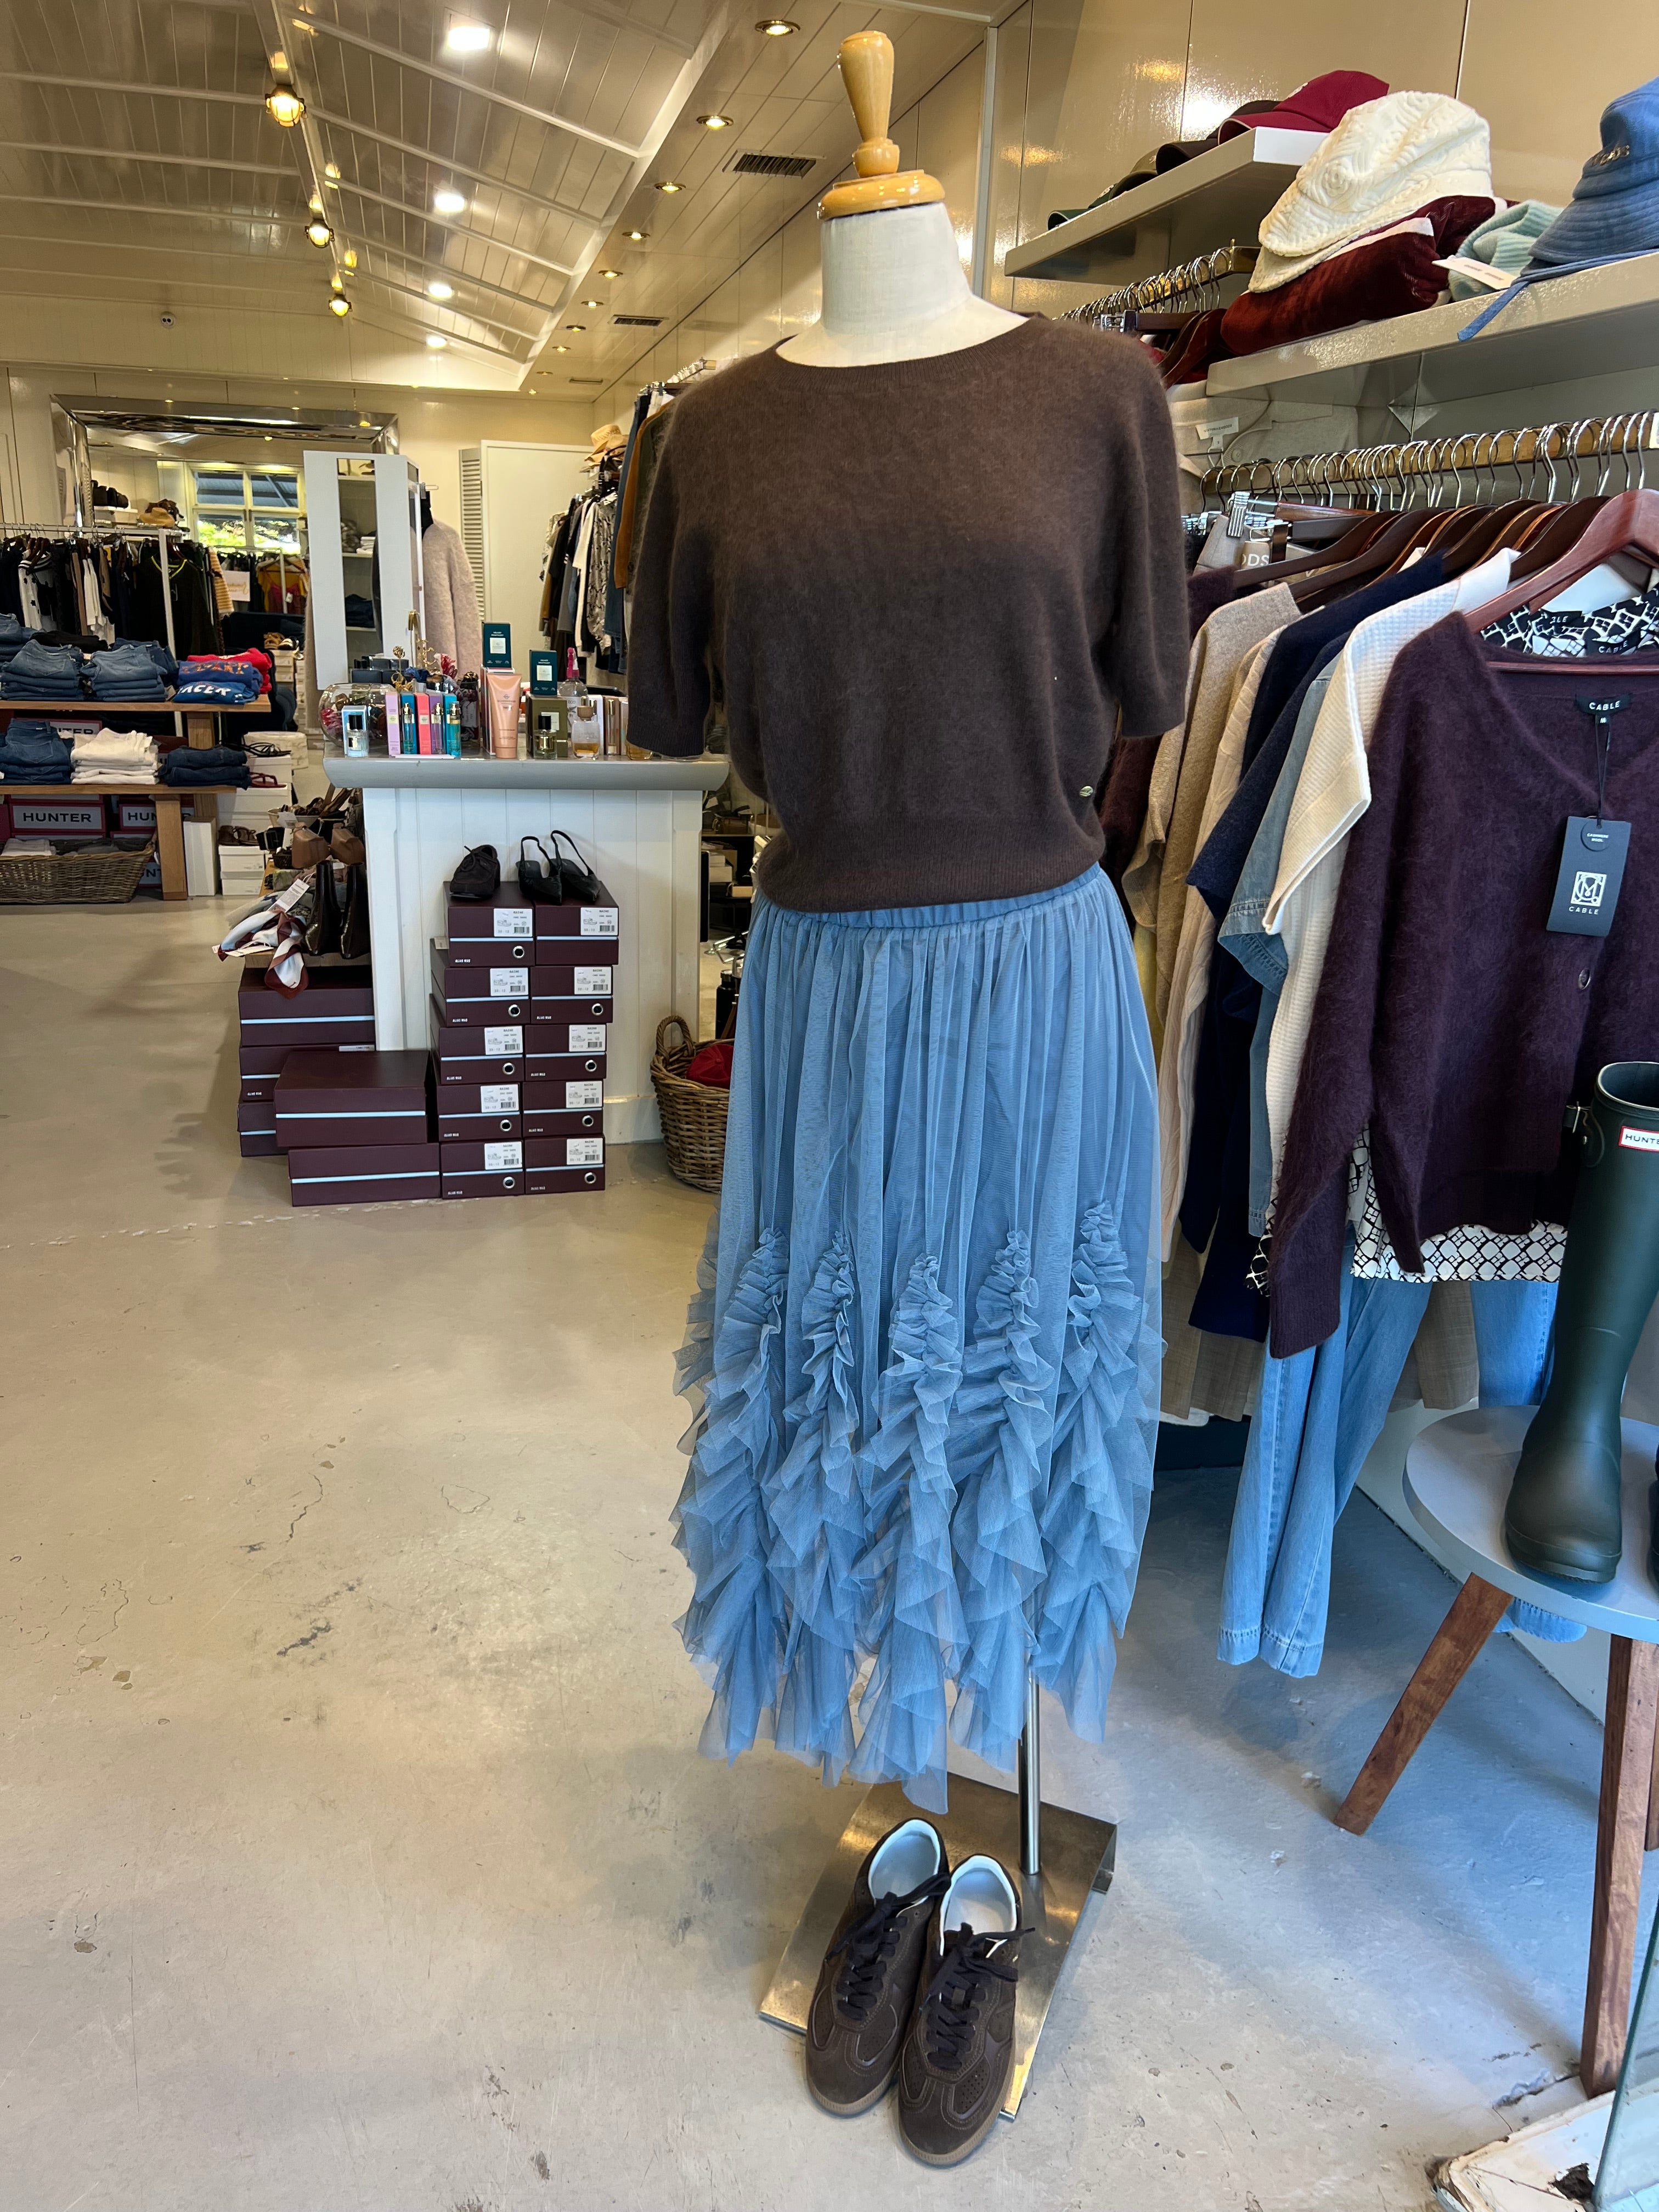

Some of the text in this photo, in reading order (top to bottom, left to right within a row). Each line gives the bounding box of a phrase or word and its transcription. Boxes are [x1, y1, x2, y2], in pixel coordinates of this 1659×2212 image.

[1598, 640, 1628, 654] CABLE
[1589, 700, 1621, 711] CABLE
[22, 812, 92, 823] HUNTER
[1568, 906, 1599, 915] CABLE
